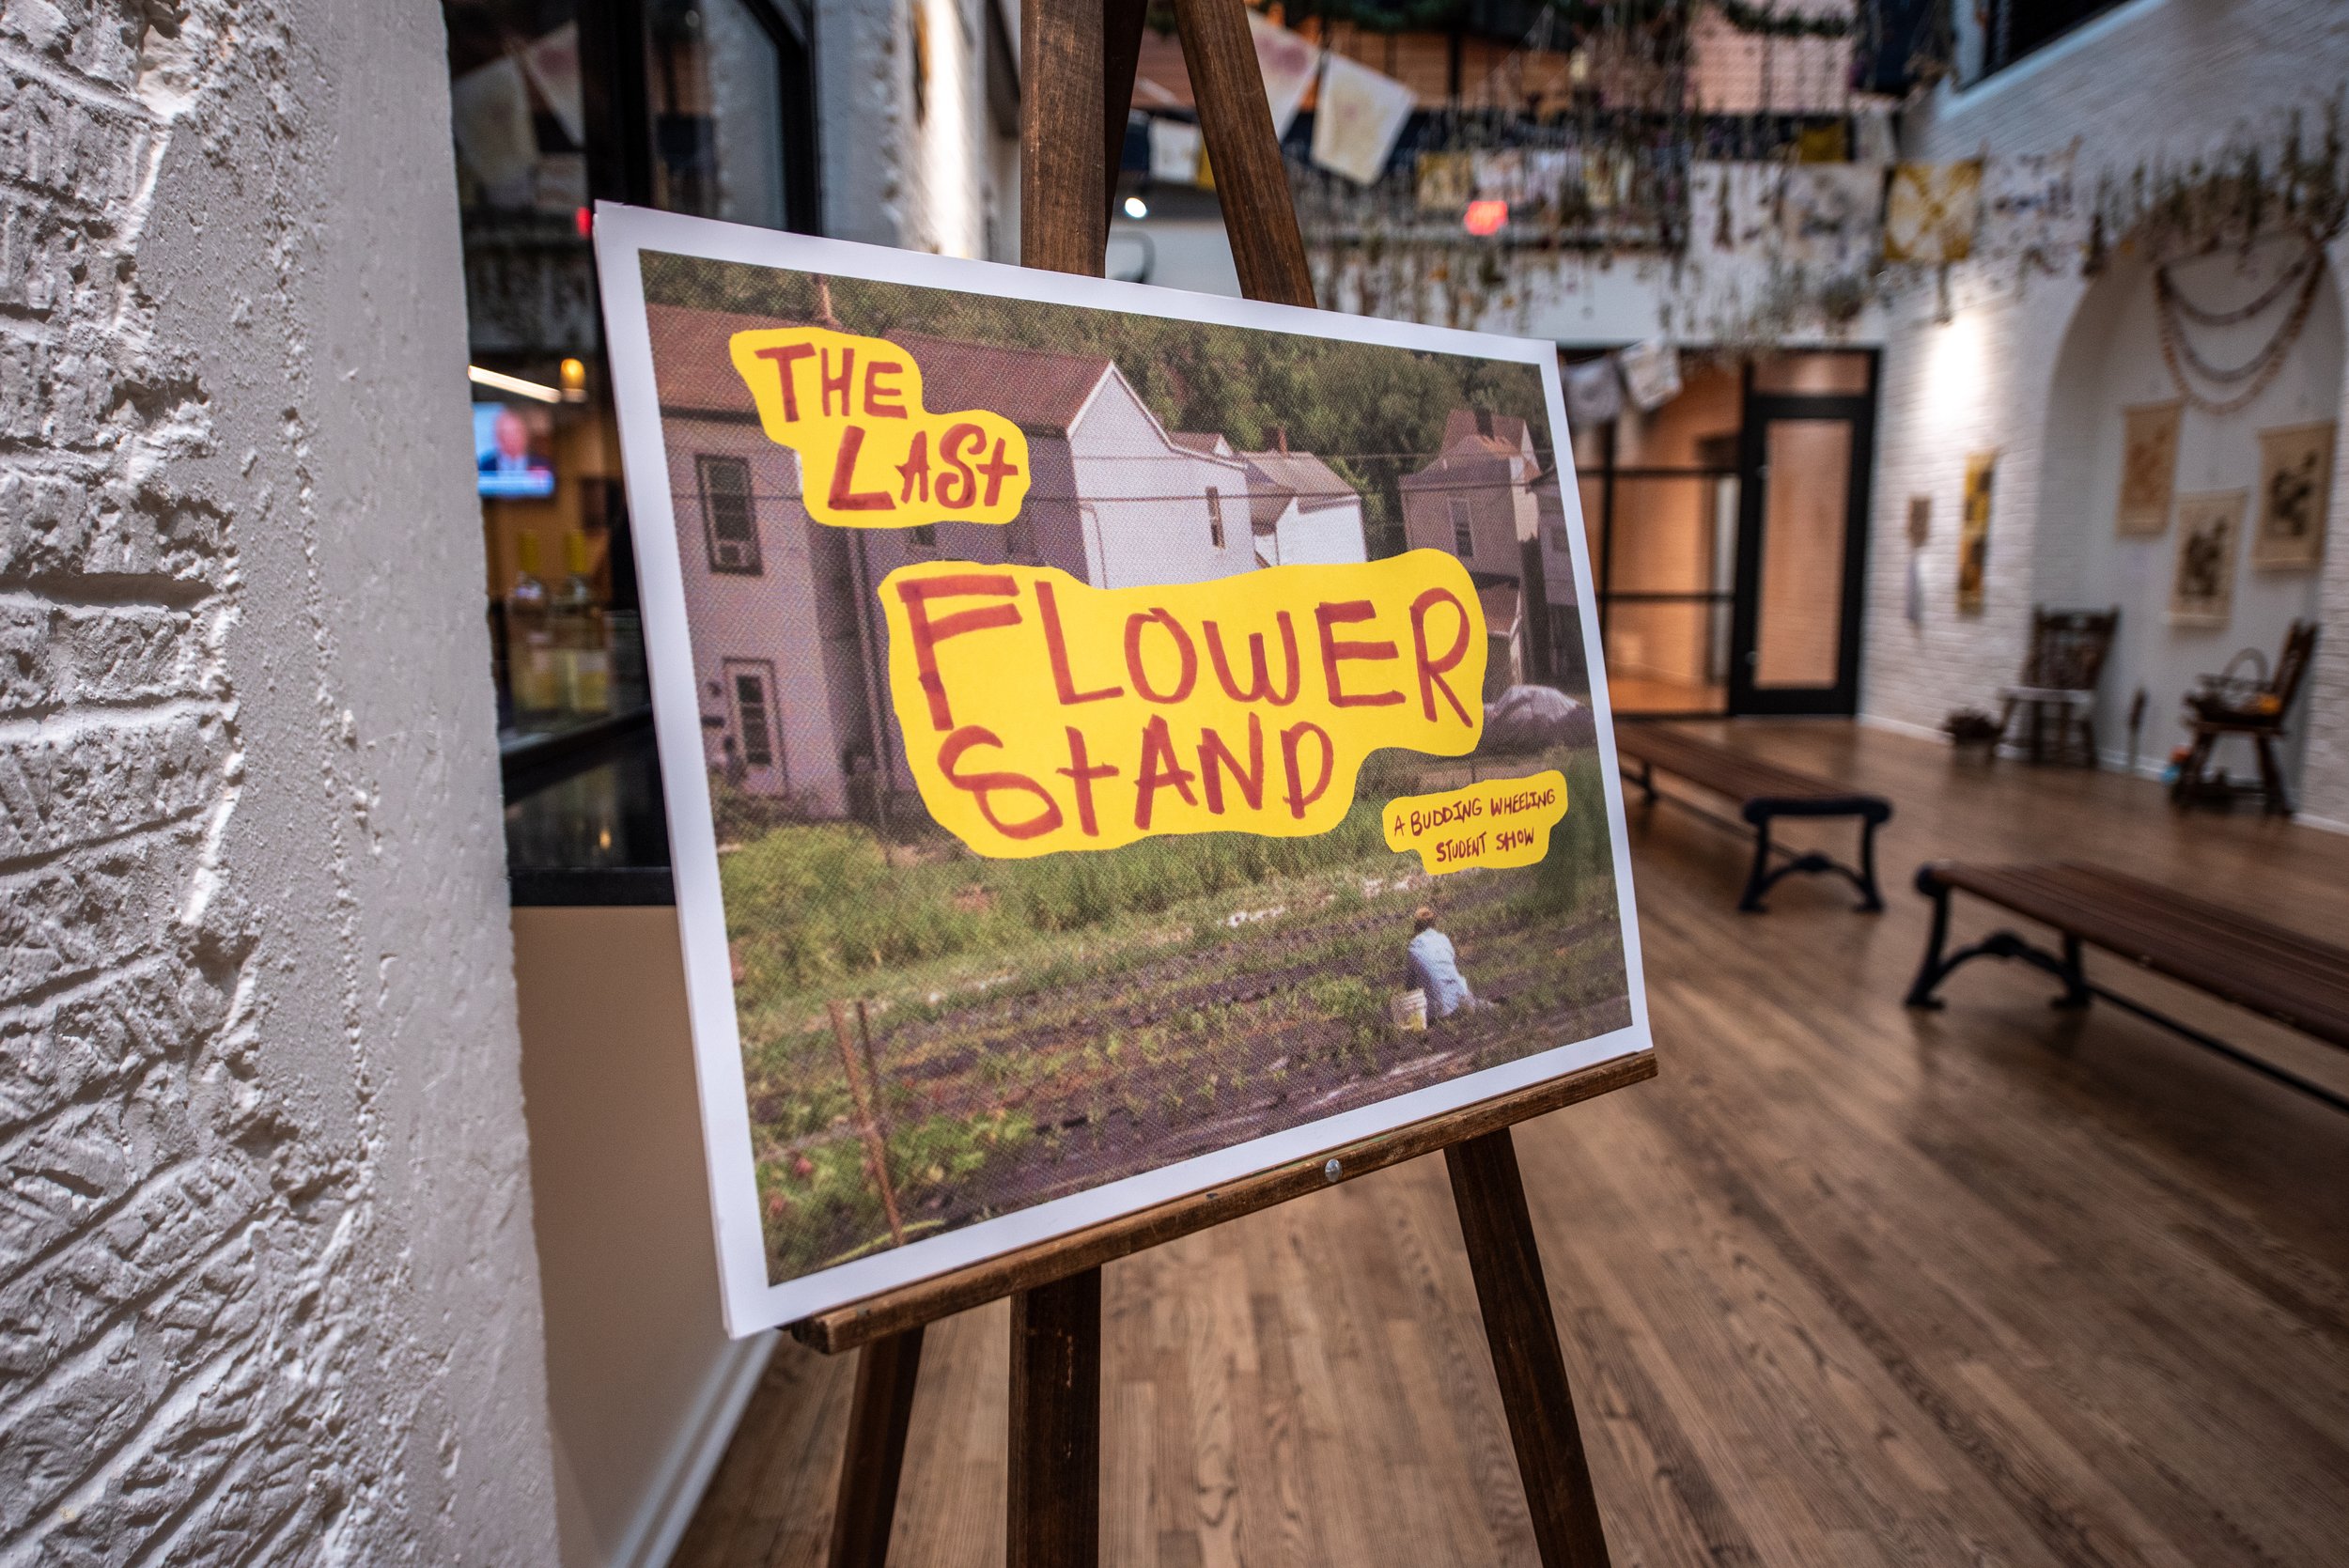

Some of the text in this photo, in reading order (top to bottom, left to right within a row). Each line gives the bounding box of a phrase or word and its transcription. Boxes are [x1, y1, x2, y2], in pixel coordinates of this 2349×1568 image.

[754, 342, 908, 422] THE
[895, 574, 1473, 731] FLOWER
[1393, 788, 1556, 837] A BUDDING WHEELING
[1436, 827, 1534, 862] STUDENT SHOW
